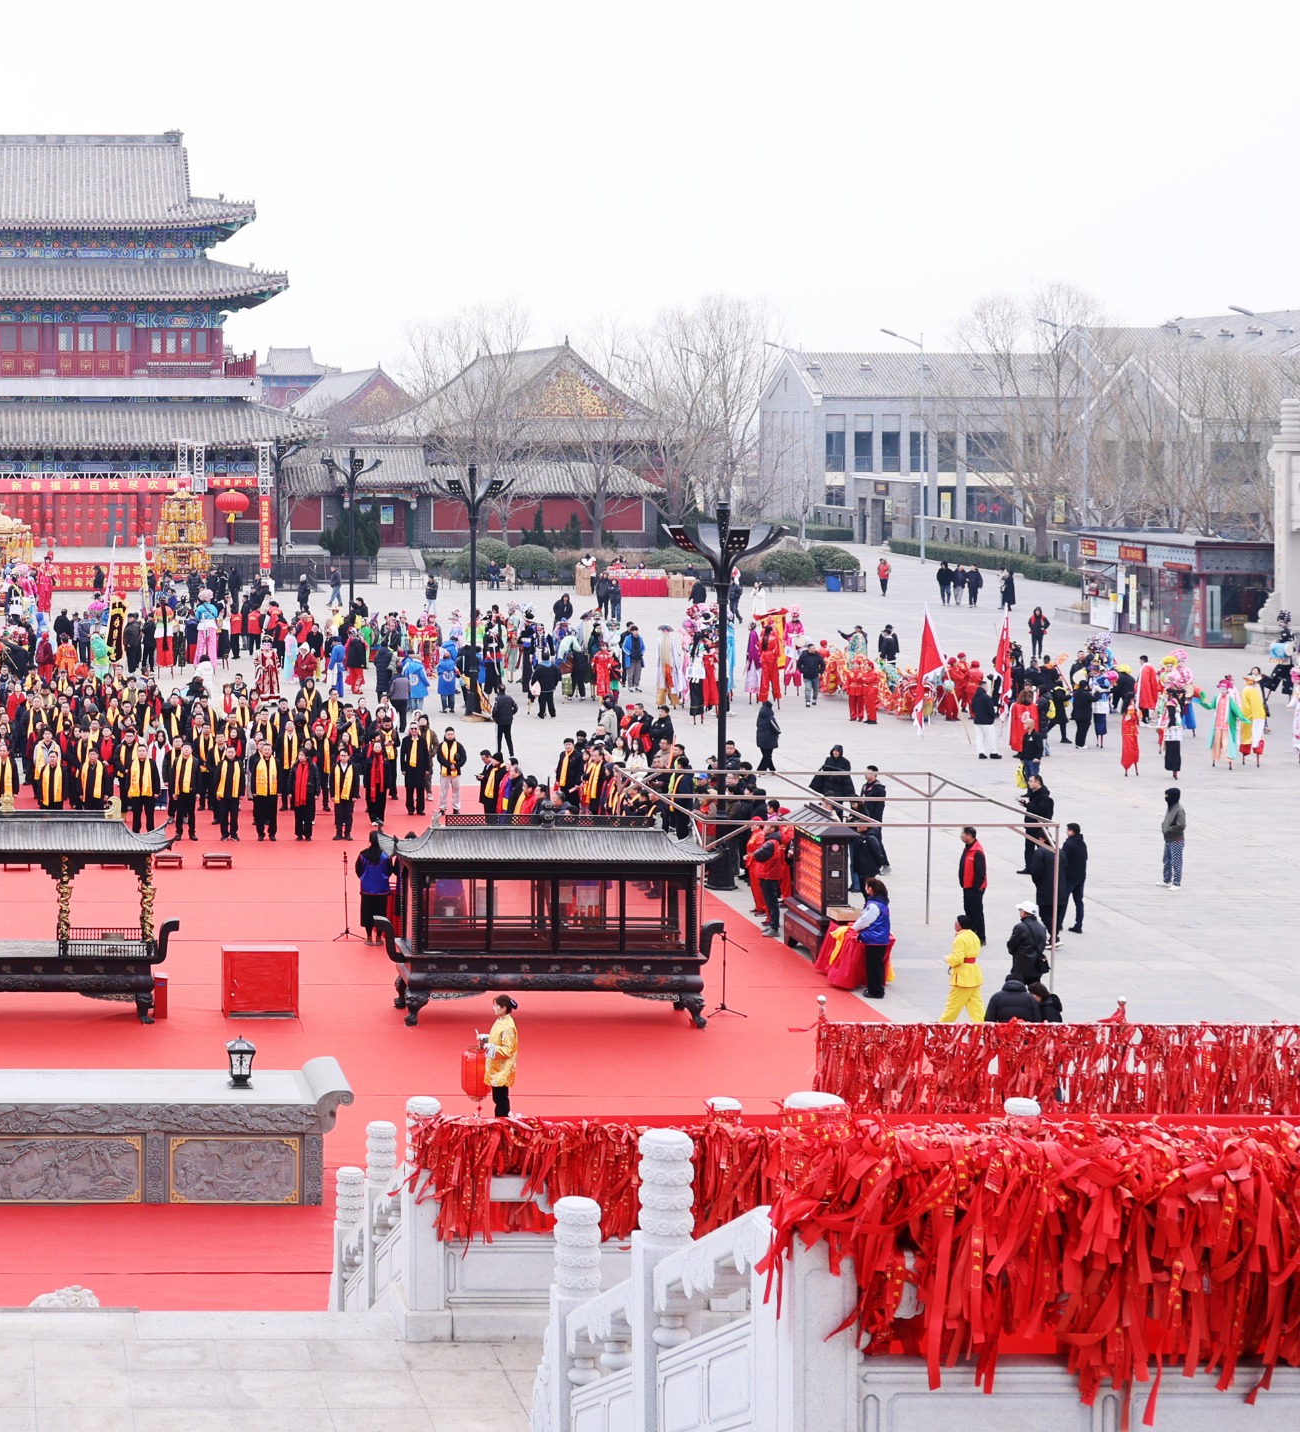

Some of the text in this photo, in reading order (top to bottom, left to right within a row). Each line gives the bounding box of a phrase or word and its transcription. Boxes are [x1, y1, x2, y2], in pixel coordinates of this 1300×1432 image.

[11, 480, 179, 491] 新春福泽百姓尽欢颜
